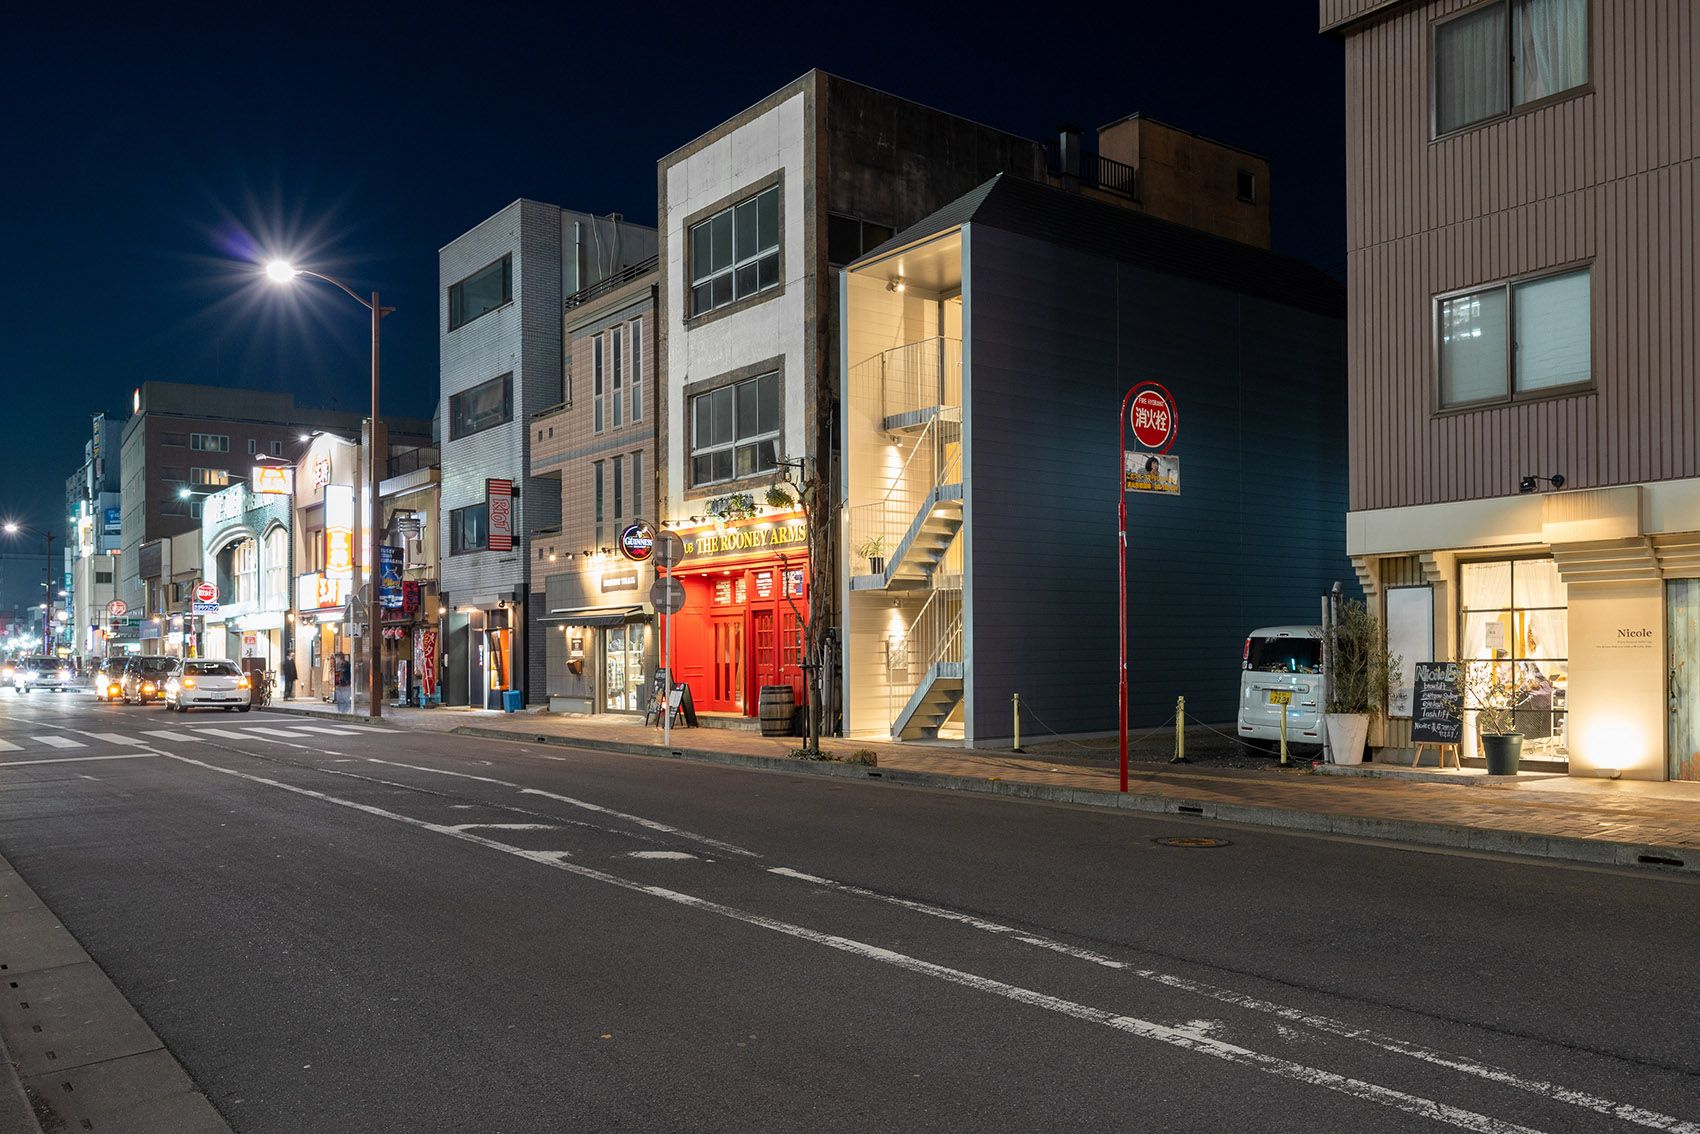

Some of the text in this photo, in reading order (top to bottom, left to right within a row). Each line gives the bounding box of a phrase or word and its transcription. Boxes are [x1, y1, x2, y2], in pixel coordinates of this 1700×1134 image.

[1135, 406, 1167, 431] 消火栓
[624, 536, 653, 546] GUINNESS
[696, 536, 719, 555] THE
[720, 528, 769, 551] ROONEY
[770, 524, 807, 545] ARMS
[1617, 628, 1653, 638] Nicole
